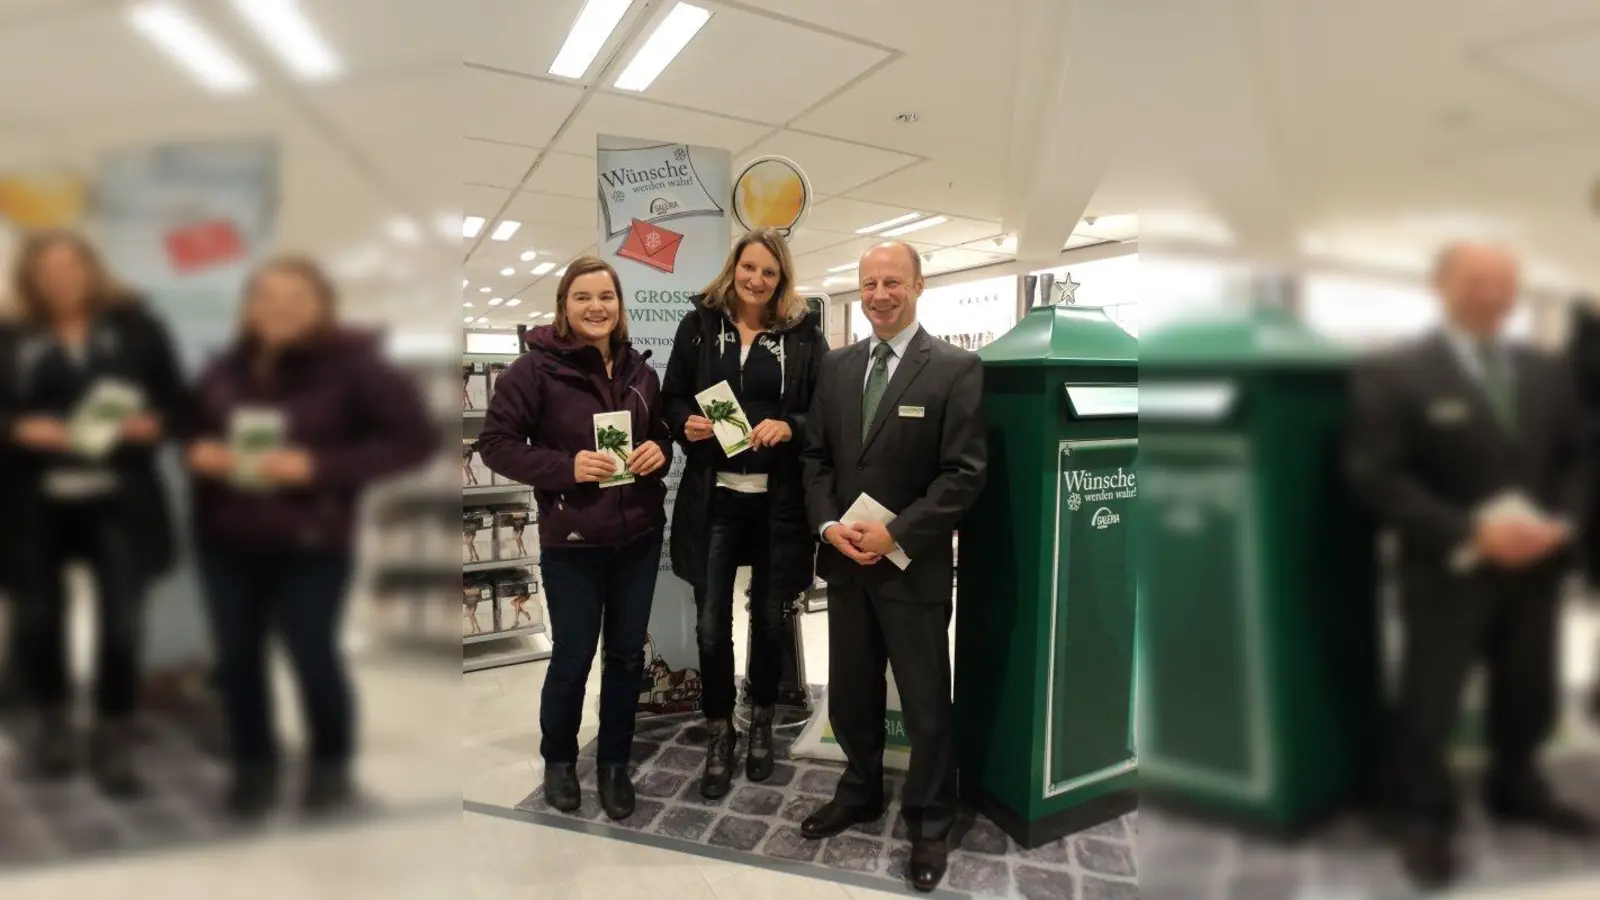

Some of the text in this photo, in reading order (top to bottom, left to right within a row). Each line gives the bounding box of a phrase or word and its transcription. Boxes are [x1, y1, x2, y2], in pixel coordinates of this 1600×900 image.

[601, 160, 688, 188] Wünsche
[632, 177, 693, 193] werden wahr!
[635, 290, 694, 304] GROSS
[627, 308, 687, 321] WINNS
[630, 336, 675, 346] UNKTION
[1064, 468, 1135, 492] Wünsche
[1085, 487, 1137, 501] werden wahr!
[1097, 514, 1120, 525] GALERIA
